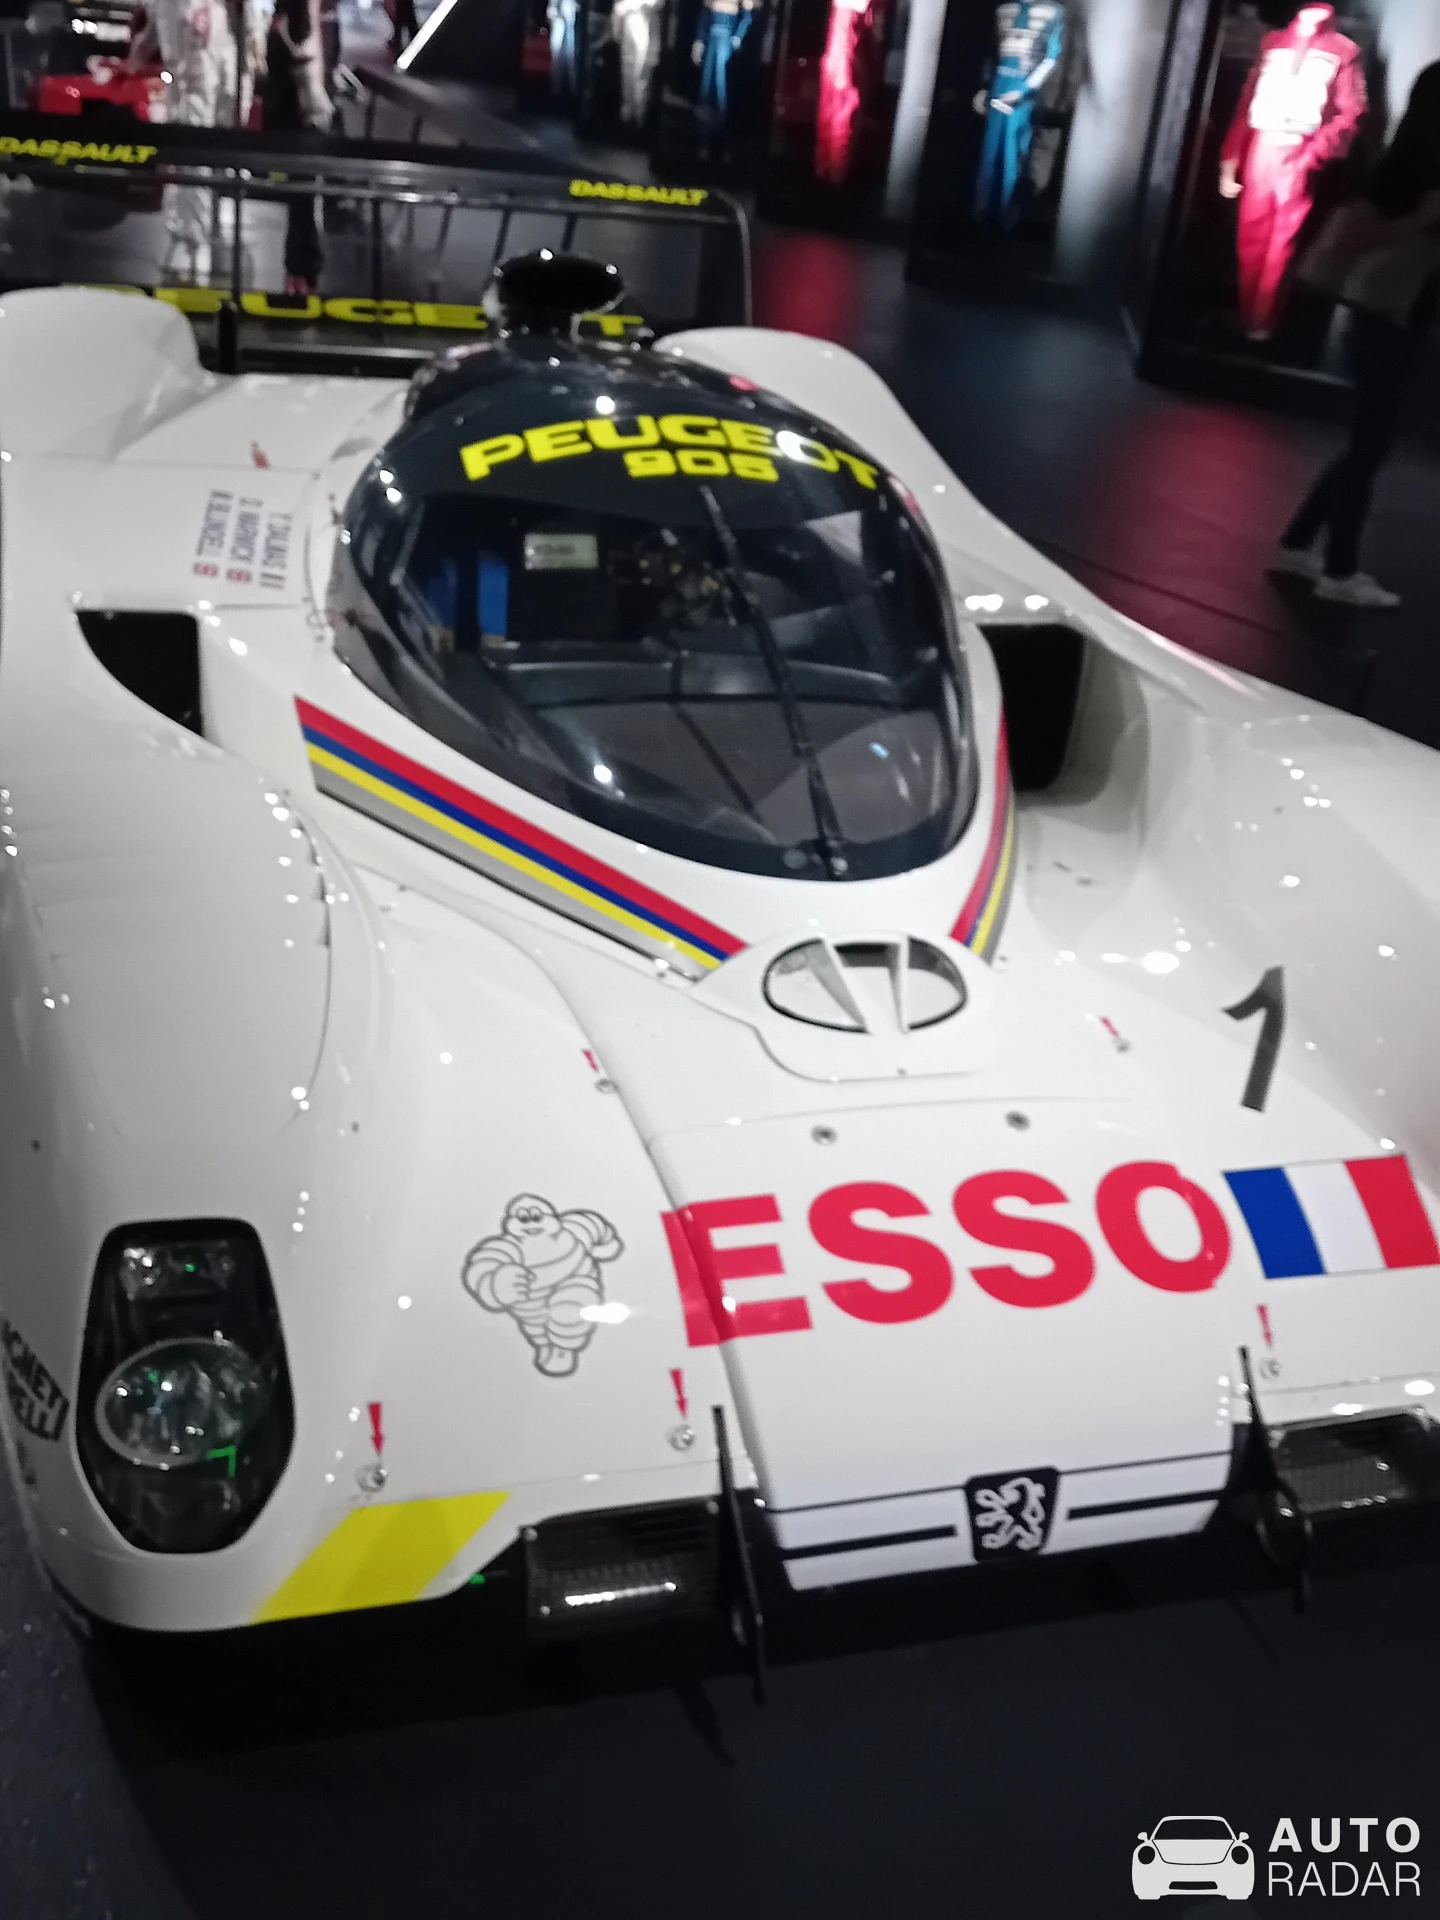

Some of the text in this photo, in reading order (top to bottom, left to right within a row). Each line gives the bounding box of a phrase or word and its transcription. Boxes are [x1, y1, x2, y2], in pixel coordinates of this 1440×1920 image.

[569, 179, 708, 206] DASSAULT
[460, 413, 878, 490] PEUGEOT
[622, 448, 780, 483] 905
[1224, 967, 1287, 1113] 1
[661, 1160, 1231, 1347] ESSO
